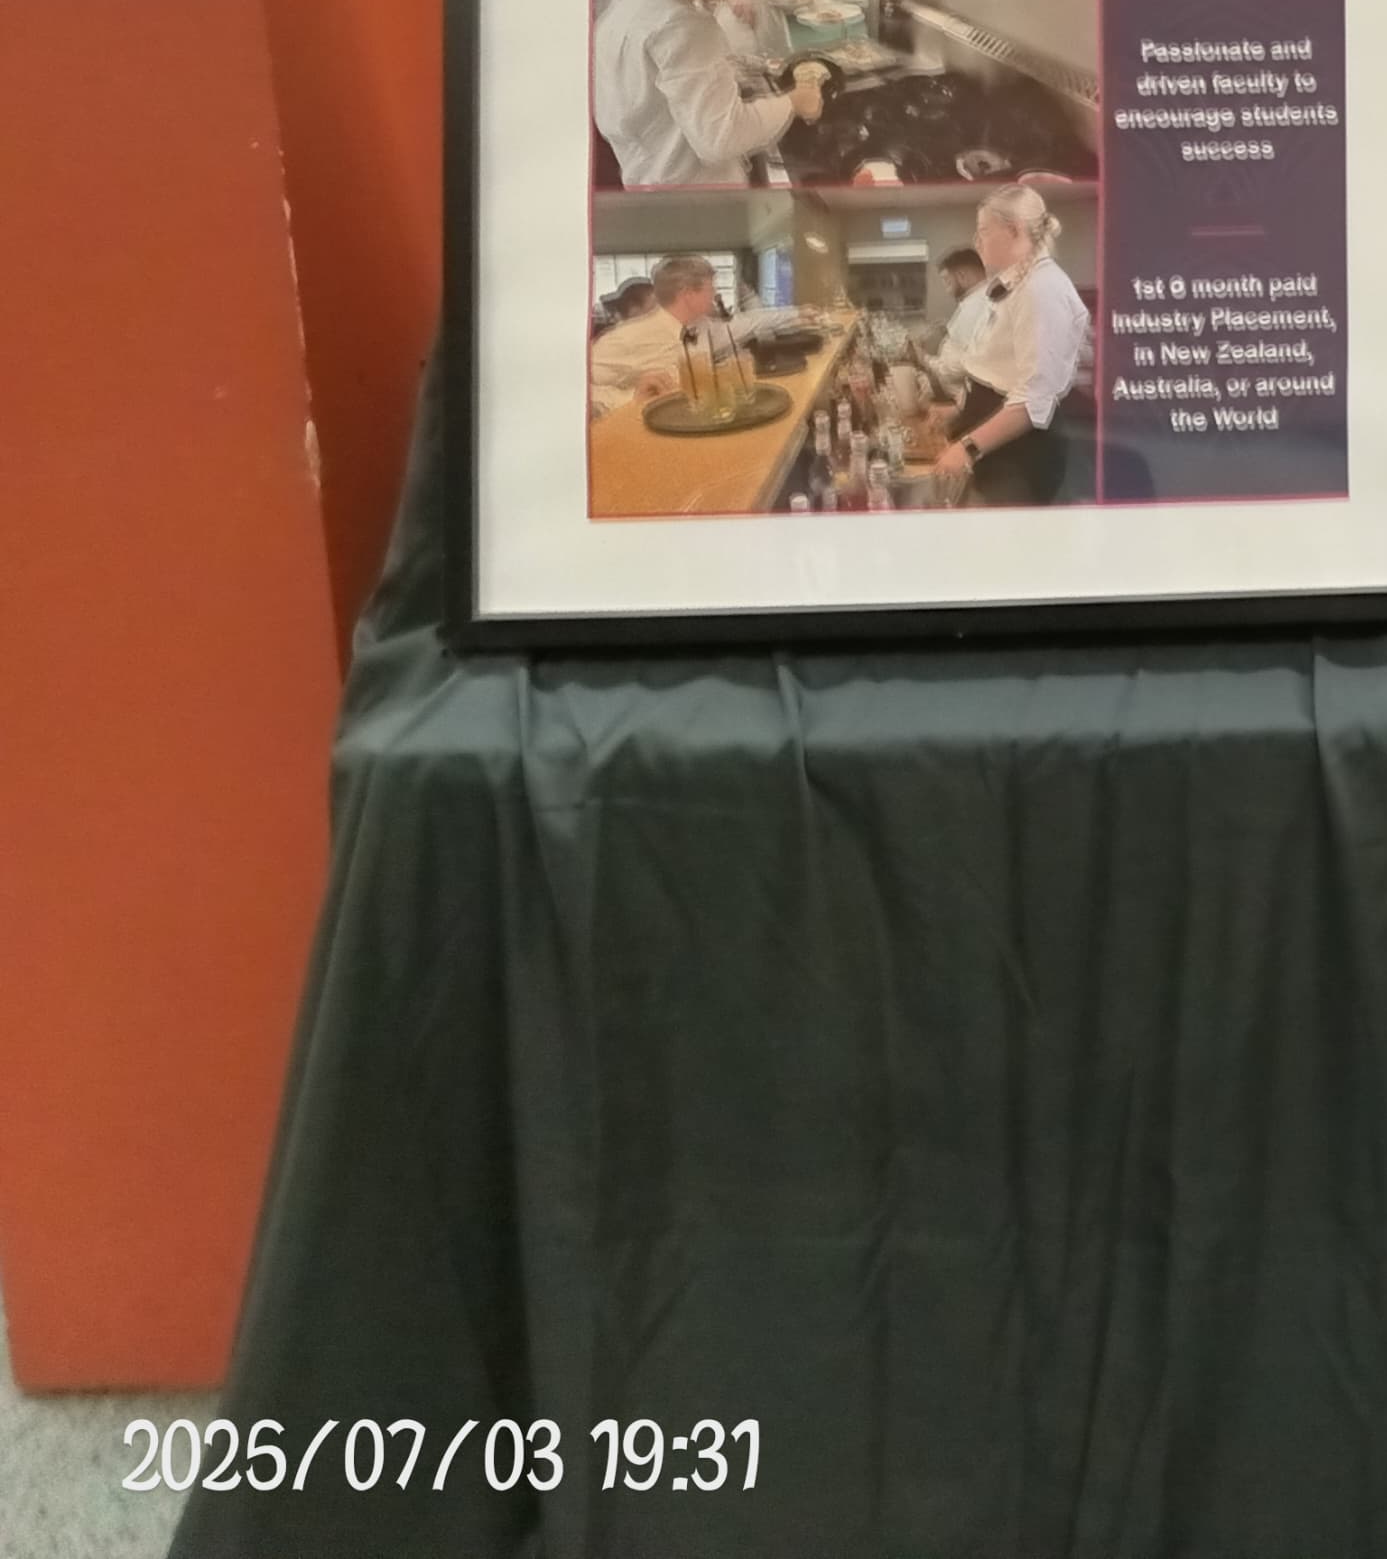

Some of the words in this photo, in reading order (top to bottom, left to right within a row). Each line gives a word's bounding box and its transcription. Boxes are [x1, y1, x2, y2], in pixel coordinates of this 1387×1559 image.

[1140, 39, 1265, 63] Passionate
[1270, 37, 1312, 60] and
[1136, 73, 1206, 96] driven
[1212, 72, 1288, 98] faculty
[1295, 73, 1317, 93] to
[1115, 109, 1235, 132] encourage
[1241, 103, 1338, 126] students
[1181, 142, 1275, 161] success
[1132, 277, 1165, 300] 1st
[1192, 274, 1264, 298] month
[1269, 273, 1318, 301] paid
[1112, 310, 1205, 337] Industry
[1210, 307, 1337, 332] Placement,
[1133, 343, 1155, 366] in
[1161, 342, 1210, 365] New
[1216, 340, 1314, 365] Zealand,
[1112, 376, 1221, 401] Australia,
[1227, 377, 1251, 398] or
[1255, 372, 1335, 396] around
[1170, 410, 1208, 432] the
[1214, 407, 1279, 430] World
